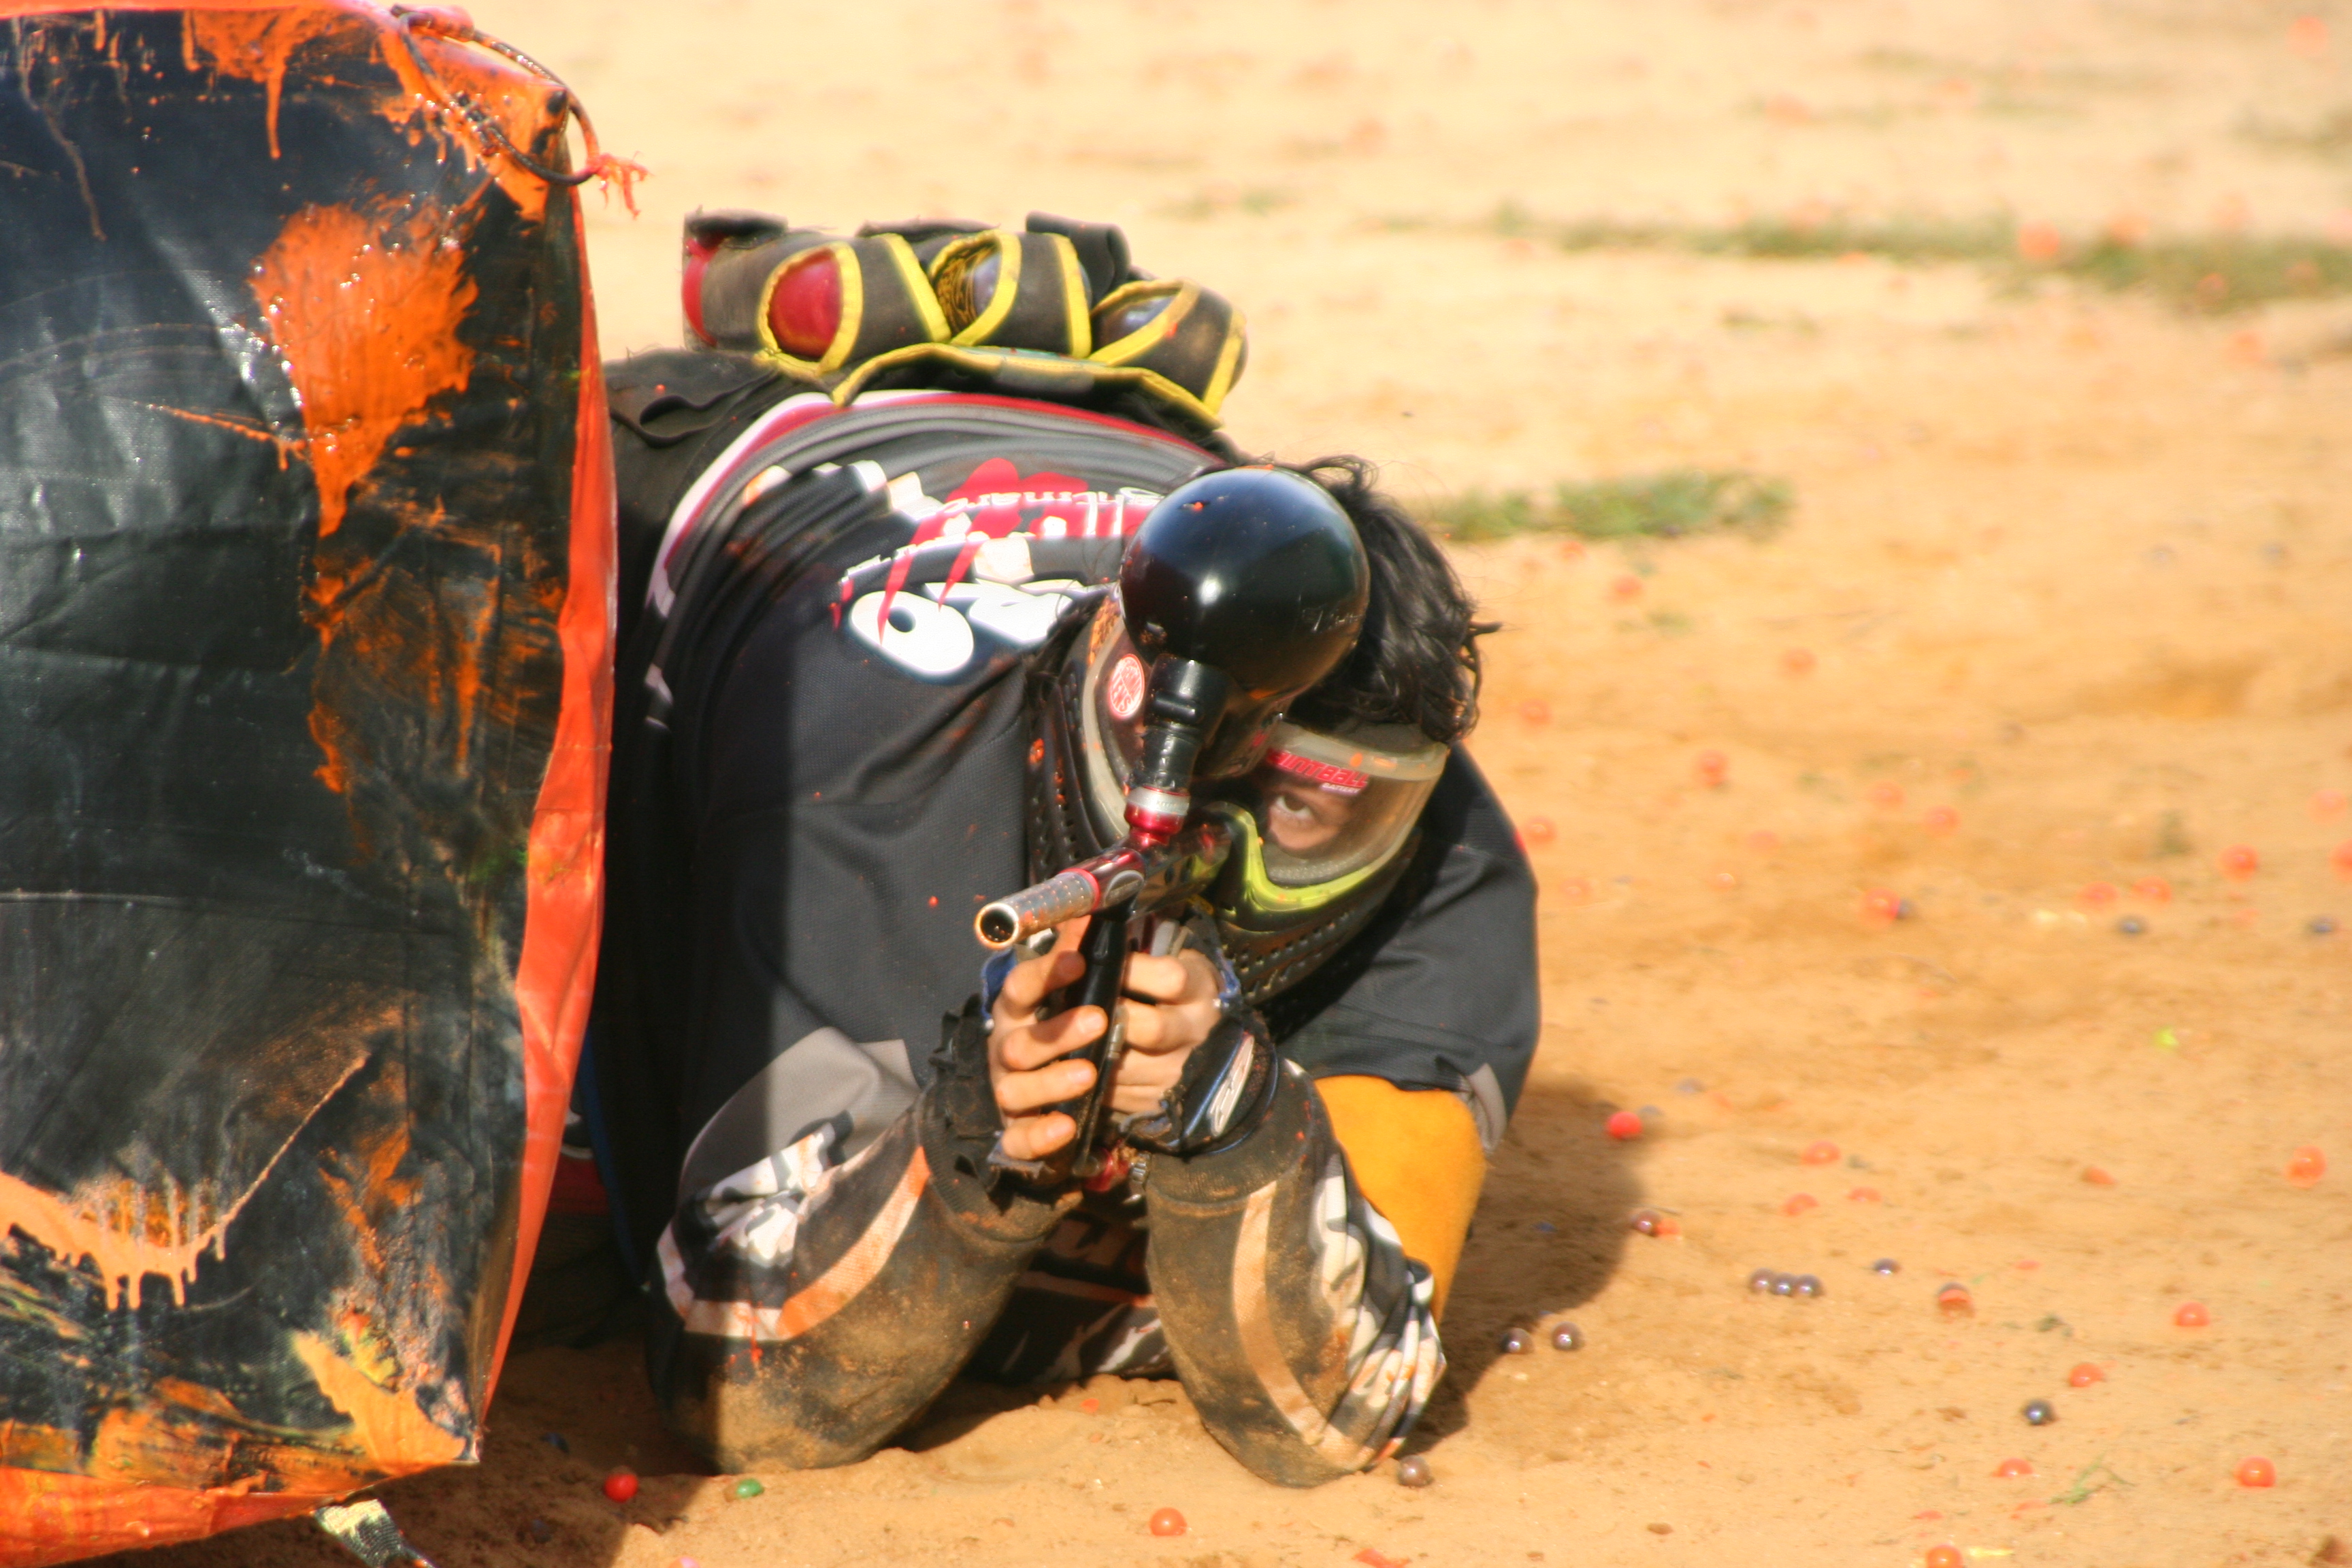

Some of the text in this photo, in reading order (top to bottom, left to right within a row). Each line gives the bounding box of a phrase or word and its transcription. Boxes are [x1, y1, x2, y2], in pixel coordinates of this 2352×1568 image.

[941, 487, 1158, 539] ghtmare
[1110, 671, 1132, 713] LENS
[1266, 747, 1369, 789] AINTBALL
